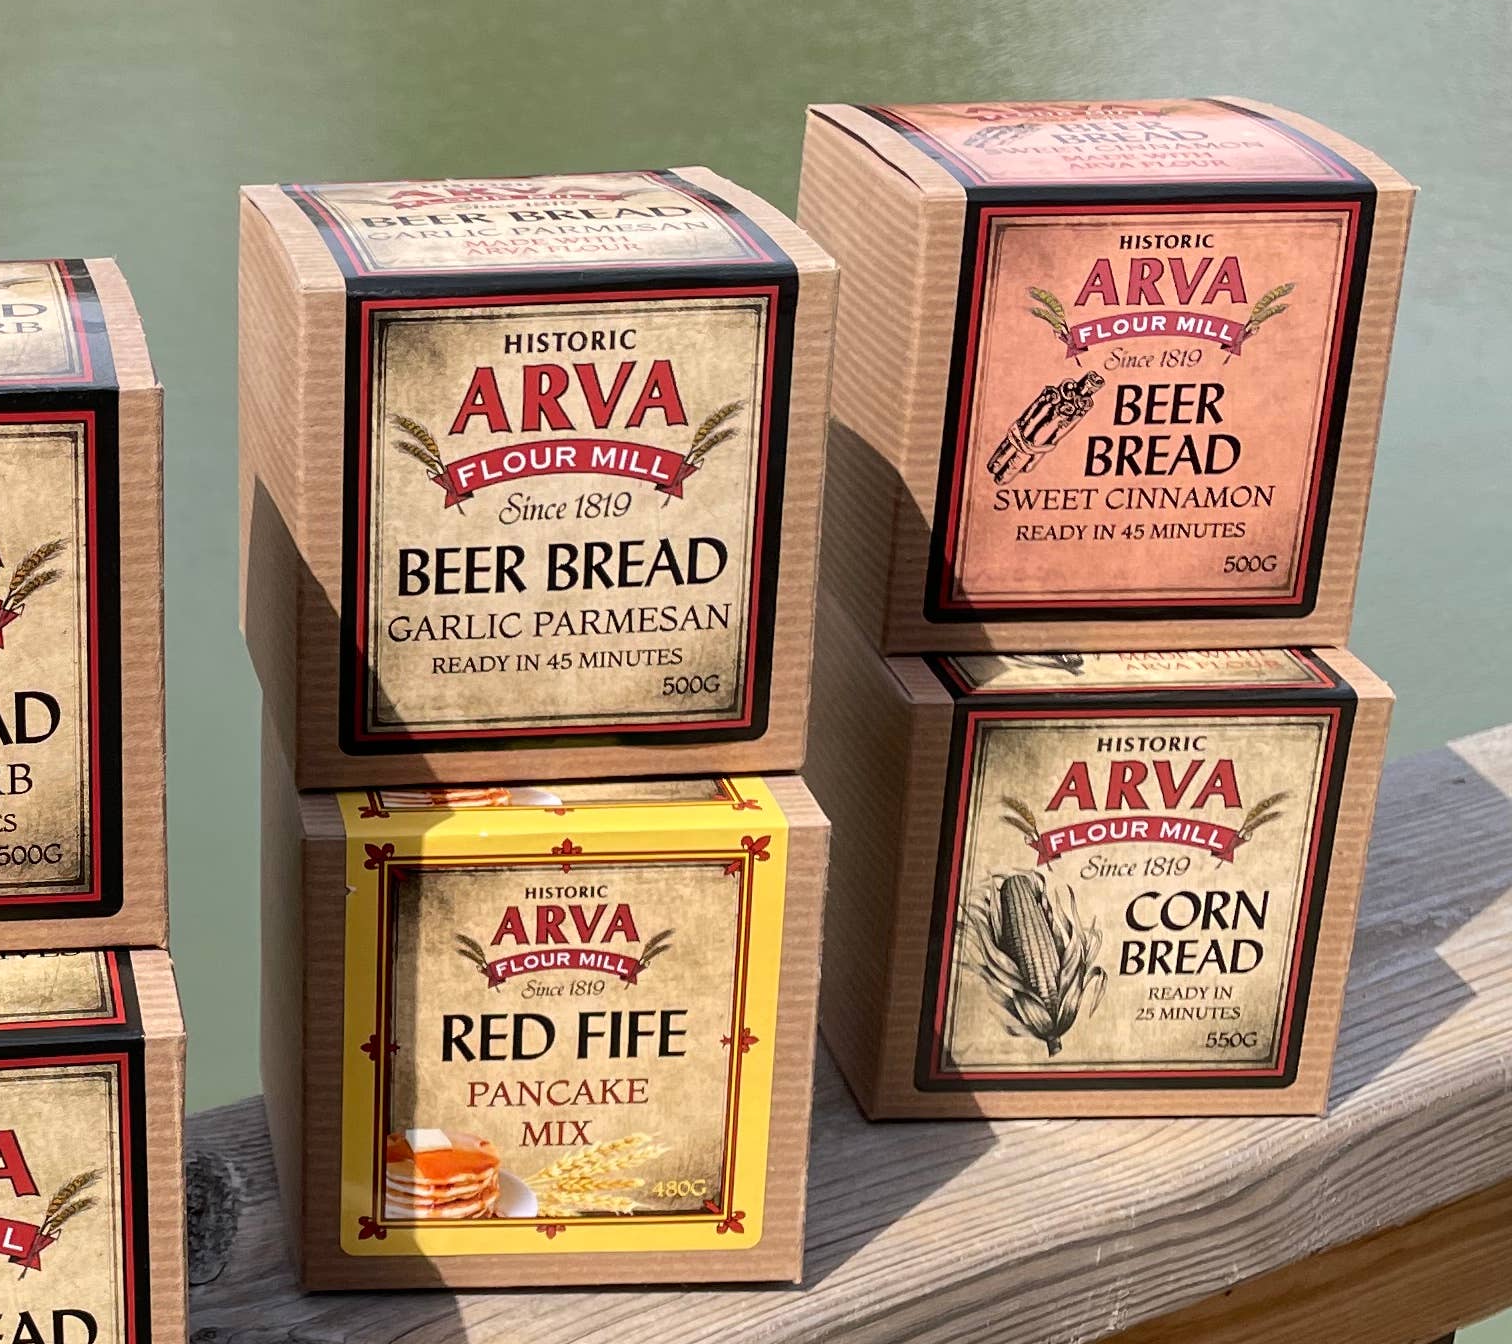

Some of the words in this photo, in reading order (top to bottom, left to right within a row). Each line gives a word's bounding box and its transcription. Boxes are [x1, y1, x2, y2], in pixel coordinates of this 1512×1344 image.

[359, 212, 493, 228] BEER
[507, 206, 693, 222] BREAD
[1119, 233, 1216, 251] HISTORIC
[1073, 255, 1249, 307] ARVA
[503, 328, 638, 355] HISTORIC
[1078, 315, 1167, 343] FLOUR
[1176, 316, 1235, 343] MILL
[1102, 347, 1155, 371] Since
[1160, 346, 1203, 368] 1819
[448, 358, 689, 435] ARVA
[1112, 381, 1226, 427] BEER
[457, 446, 578, 488] FLOUR
[590, 446, 671, 481] MILL
[1083, 434, 1243, 478] BREAD
[498, 492, 567, 525] Since
[573, 491, 633, 521] 1819
[992, 489, 1100, 513] SWEET
[1104, 484, 1277, 511] CINNAMON
[1015, 524, 1089, 543] READY
[1093, 523, 1117, 540] IN
[1120, 523, 1146, 540] 45
[1149, 521, 1247, 540] MINUTES
[397, 544, 526, 597] BEER
[546, 536, 730, 591] BREAD
[1222, 555, 1278, 574] 500G
[387, 611, 522, 644] GARLIC
[532, 602, 733, 638] PARMESAN
[431, 655, 510, 675] READY
[515, 654, 541, 672] IN
[545, 652, 573, 671] 45
[577, 647, 684, 669] MINUTES
[661, 675, 721, 697] 500G
[1096, 735, 1207, 753] HISTORIC
[1045, 758, 1244, 812] ARVA
[1048, 819, 1150, 853] FLOUR
[1158, 822, 1225, 850] MILL
[1079, 855, 1138, 880] Since
[1142, 855, 1192, 877] 1819
[524, 885, 609, 900] HISTORIC
[489, 903, 641, 947] ARVA
[1124, 890, 1271, 932] CORN
[494, 951, 572, 978] FLOUR
[578, 951, 631, 975] MILL
[1117, 939, 1266, 978] BREAD
[520, 979, 565, 1000] Since
[568, 979, 606, 997] 1819
[1147, 985, 1212, 1002] READY
[1214, 984, 1233, 1000] IN
[1134, 1006, 1156, 1022] 25
[1157, 1005, 1242, 1022] MINUTES
[440, 1012, 557, 1063] RED
[576, 1009, 689, 1059] FIFE
[1205, 1031, 1258, 1049] 550G
[466, 1077, 650, 1108] PANCAKE
[518, 1120, 594, 1148] MIX
[651, 1178, 707, 1198] 480G
